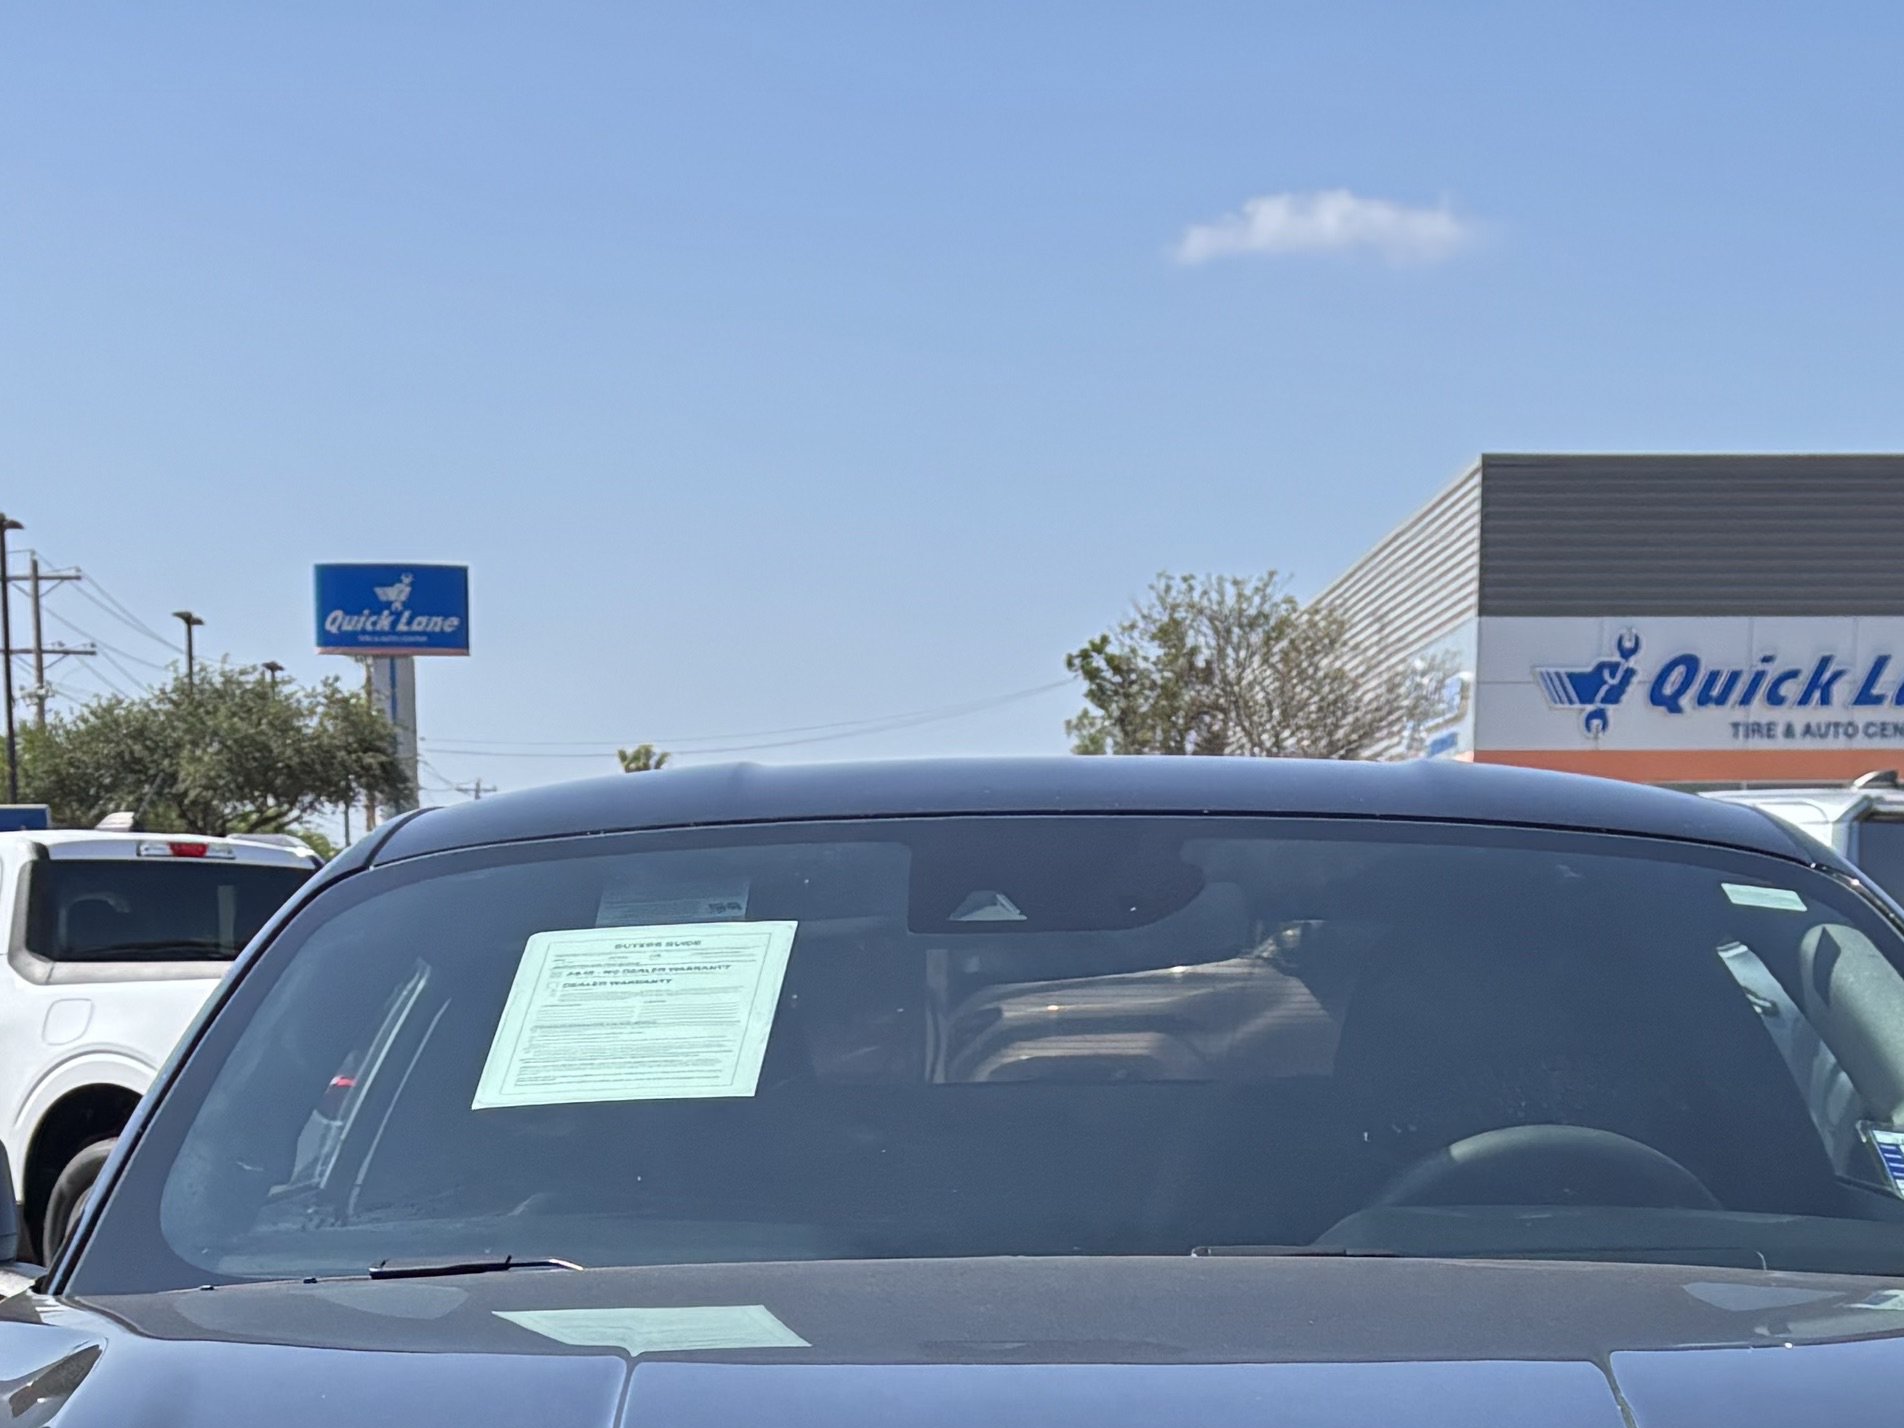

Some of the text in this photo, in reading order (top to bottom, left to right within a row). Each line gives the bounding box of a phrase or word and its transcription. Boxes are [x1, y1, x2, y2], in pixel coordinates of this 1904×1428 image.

[325, 608, 461, 635] Quick Lane
[1648, 653, 1844, 714] Quick
[1730, 721, 1777, 739] TIRE
[1782, 721, 1796, 739] &
[1802, 721, 1860, 739] AUTO
